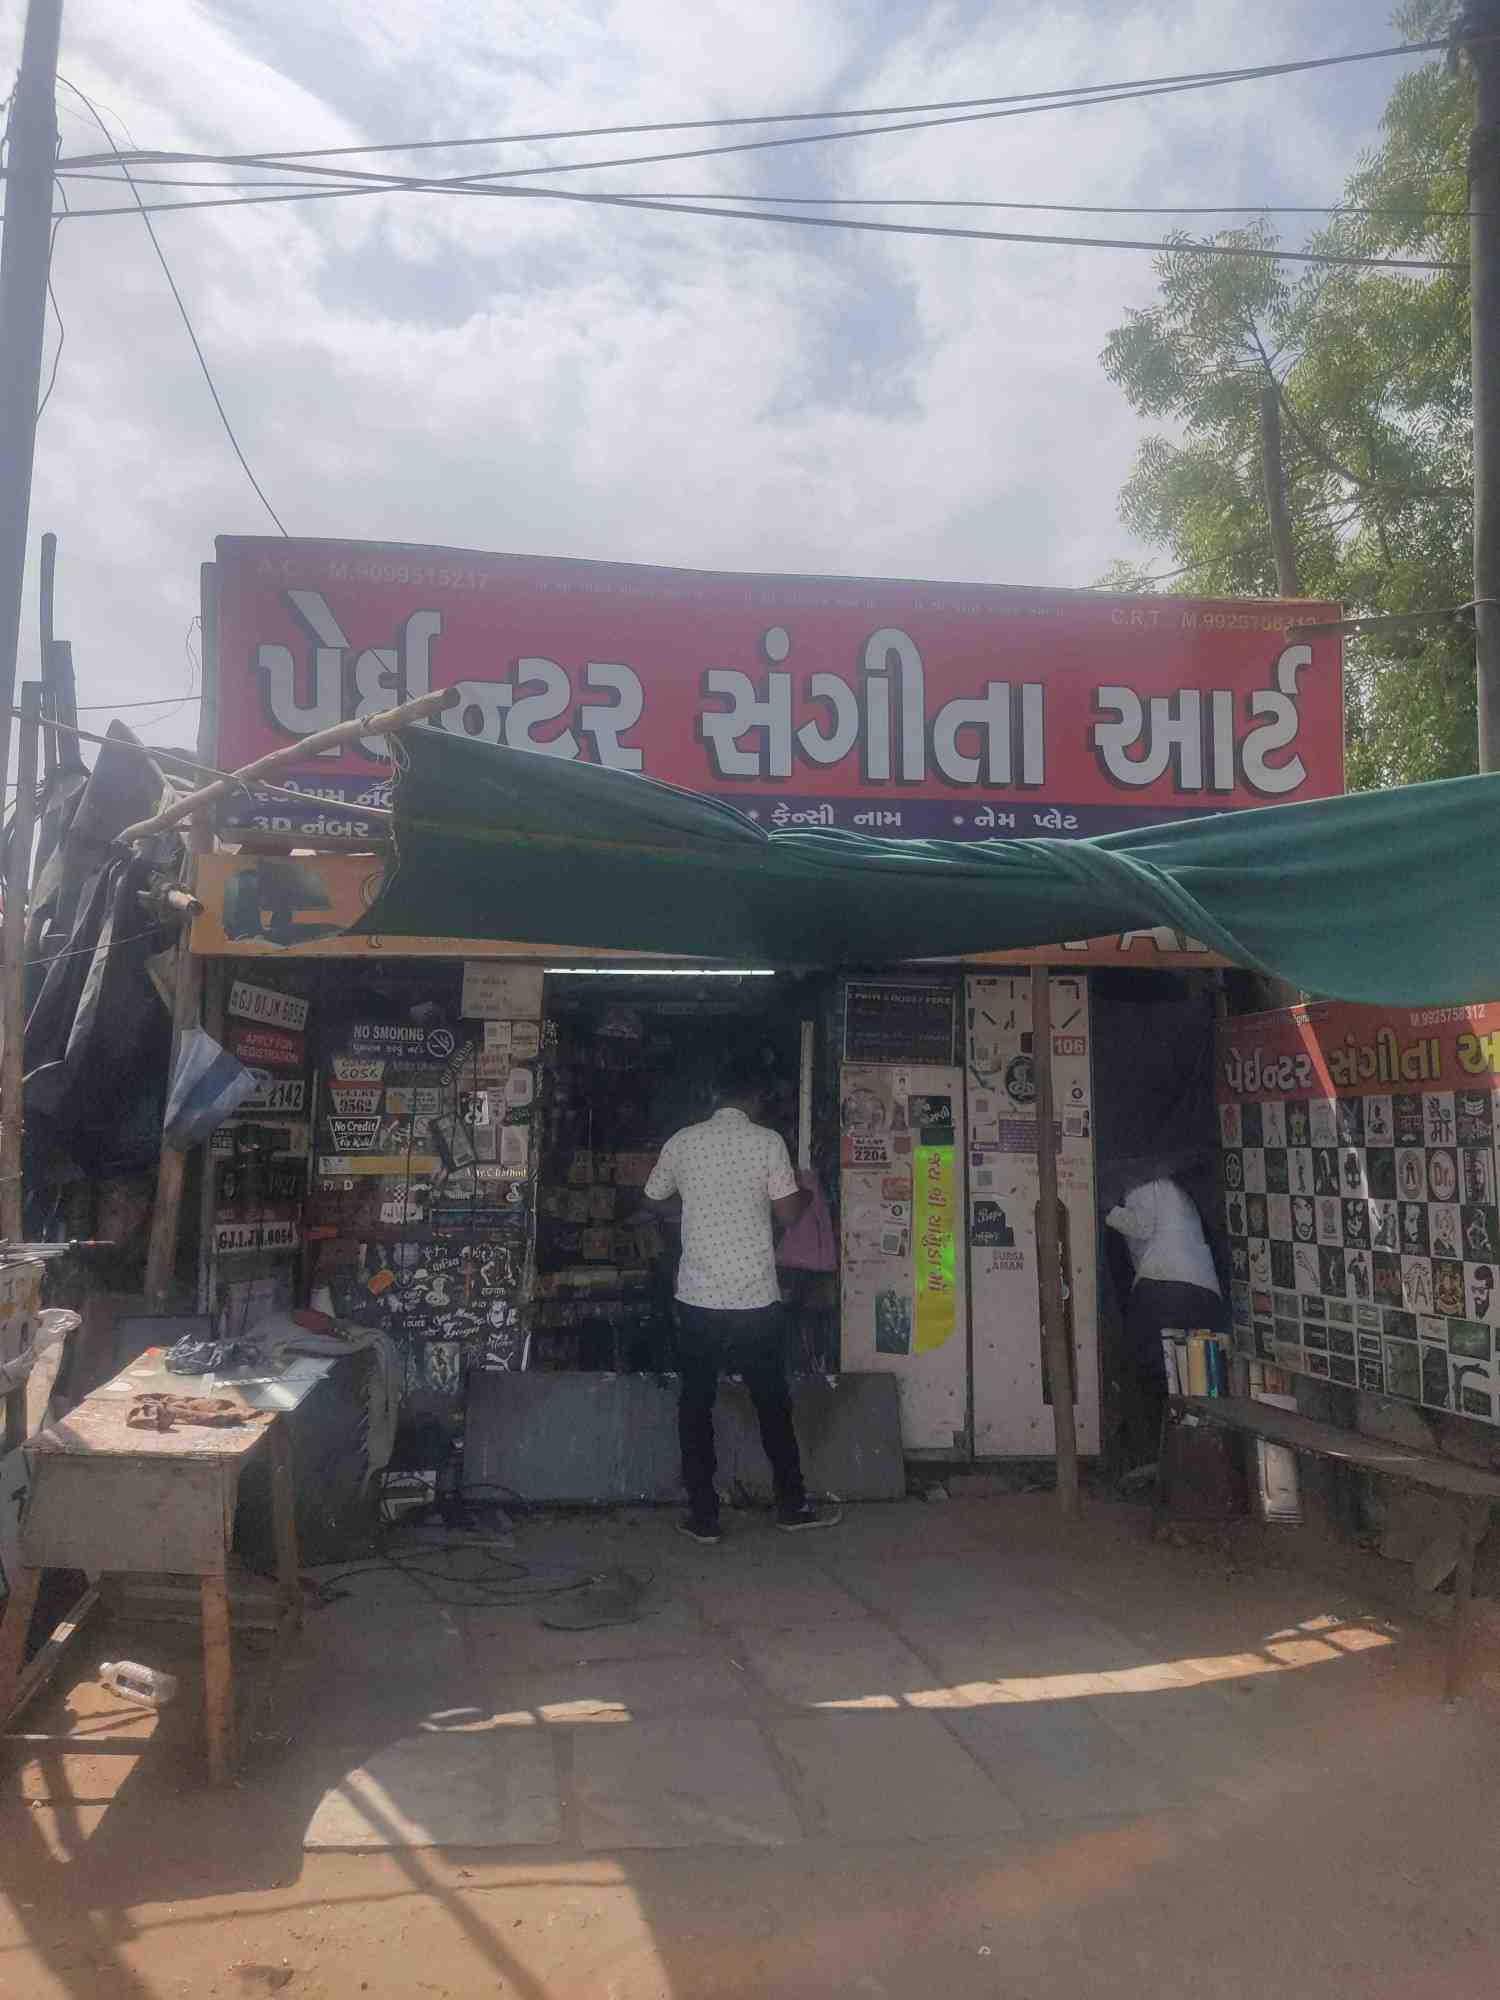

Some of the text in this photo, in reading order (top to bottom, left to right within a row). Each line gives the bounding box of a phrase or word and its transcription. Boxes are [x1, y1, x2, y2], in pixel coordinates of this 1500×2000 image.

[702, 627, 1046, 786] સંગીતા
[1095, 645, 1313, 794] આર્ટ
[301, 814, 370, 839] નંબર
[770, 802, 1080, 832] ફેન્સી નામ નેમ પ્લેટ
[354, 1025, 425, 1041] NO SMOKING
[1328, 1026, 1441, 1087] સંગીતા
[854, 1150, 888, 1162] 2204
